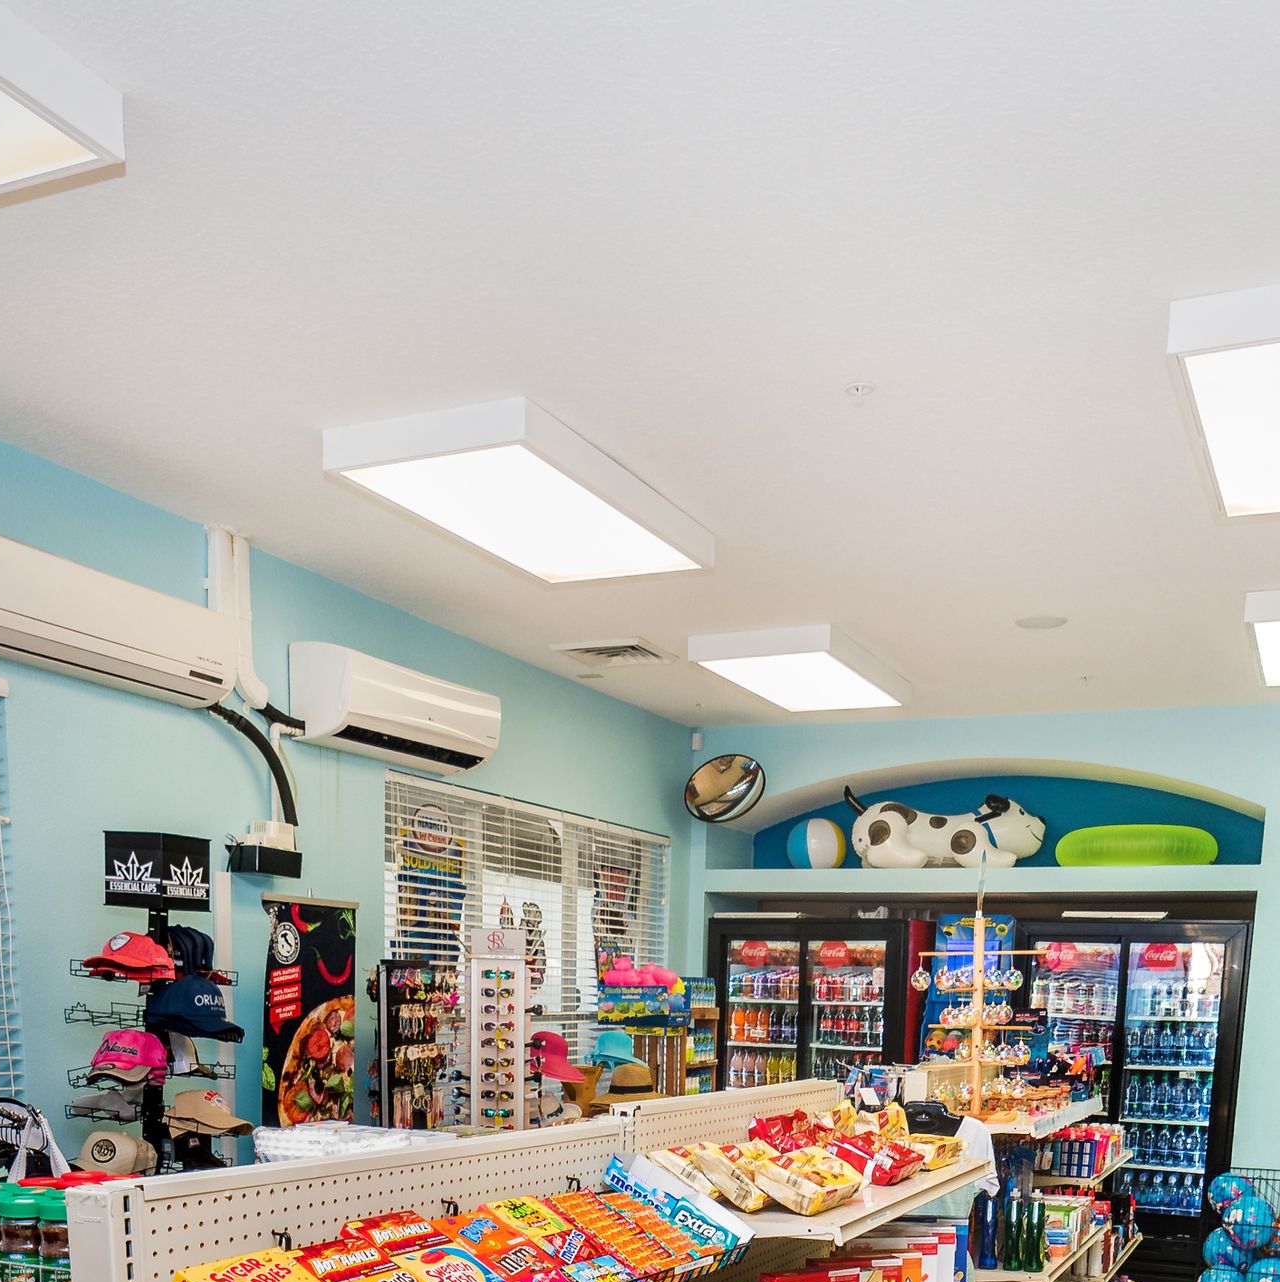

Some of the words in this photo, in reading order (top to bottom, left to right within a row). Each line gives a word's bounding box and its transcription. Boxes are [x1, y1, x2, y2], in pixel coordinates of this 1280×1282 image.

[141, 882, 157, 893] CAPS
[194, 887, 207, 898] CAPS
[1144, 950, 1176, 962] Coca-Cola
[194, 994, 226, 1007] ORLAN
[99, 1039, 138, 1056] Orlando
[608, 1171, 665, 1213] mentos
[674, 1209, 718, 1238] Extra
[560, 1229, 587, 1265] mentos
